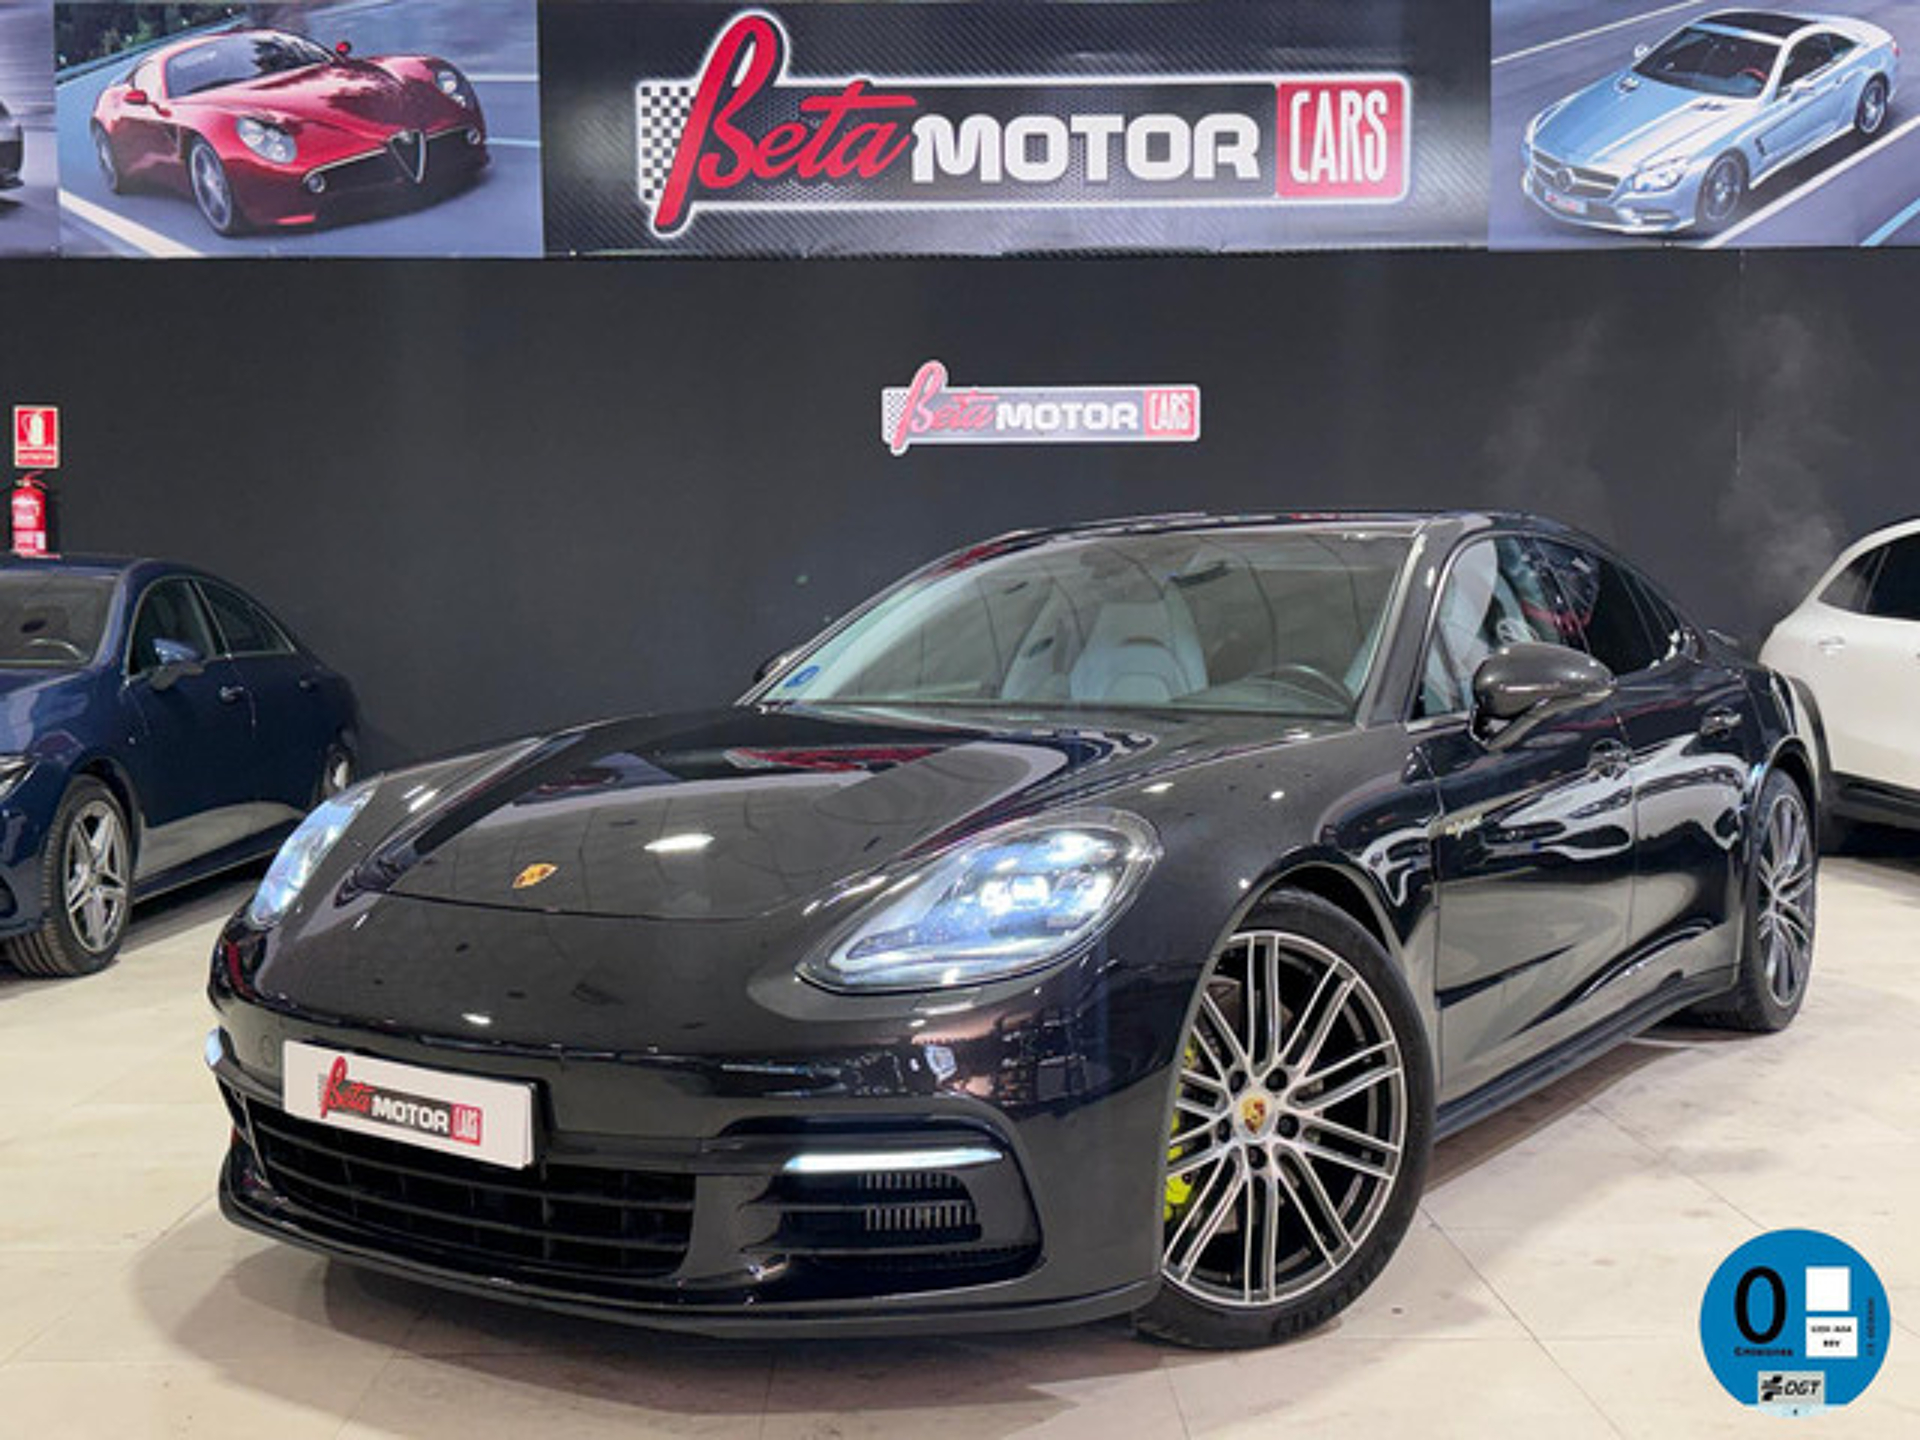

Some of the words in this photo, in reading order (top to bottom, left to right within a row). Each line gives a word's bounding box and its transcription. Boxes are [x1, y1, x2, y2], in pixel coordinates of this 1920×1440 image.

[653, 14, 918, 229] Beta
[911, 113, 1260, 184] MOTOR
[1290, 90, 1389, 184] CARS
[892, 361, 998, 449] Beta
[995, 402, 1139, 431] MOTOR
[1149, 392, 1191, 431] CARS
[371, 1095, 450, 1134] MOTOR
